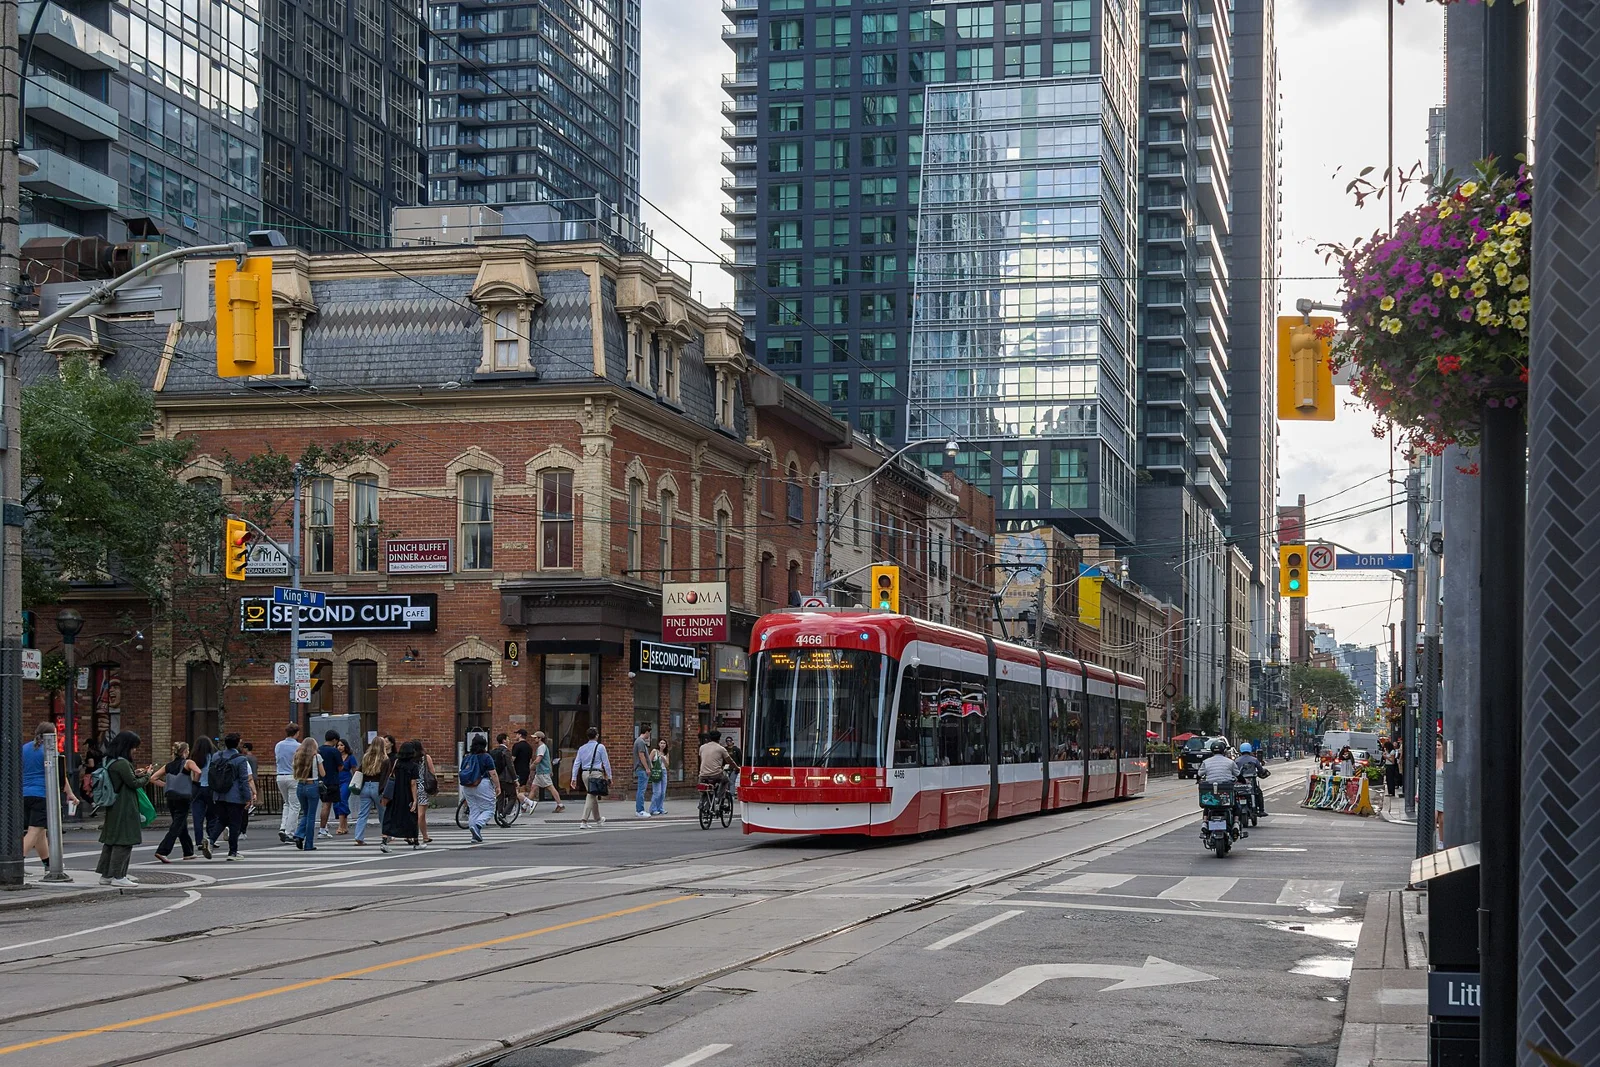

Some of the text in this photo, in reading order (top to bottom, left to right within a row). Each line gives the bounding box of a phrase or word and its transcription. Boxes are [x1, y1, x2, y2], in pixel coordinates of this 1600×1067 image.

[388, 542, 447, 552] LUNCH BUFFET
[388, 553, 419, 561] DINNER
[1355, 555, 1384, 566] John
[283, 588, 302, 604] King
[309, 593, 317, 604] W
[667, 590, 723, 604] AROMA
[272, 604, 425, 623] SECOND CUP CAFÉ
[666, 617, 724, 627] FINE INDIAN
[675, 627, 714, 637] CUISINE
[796, 635, 822, 645] 4466
[26, 652, 34, 660] NO
[651, 650, 679, 667] SECOND
[679, 654, 693, 668] CUP
[1448, 981, 1481, 1007] Litt
